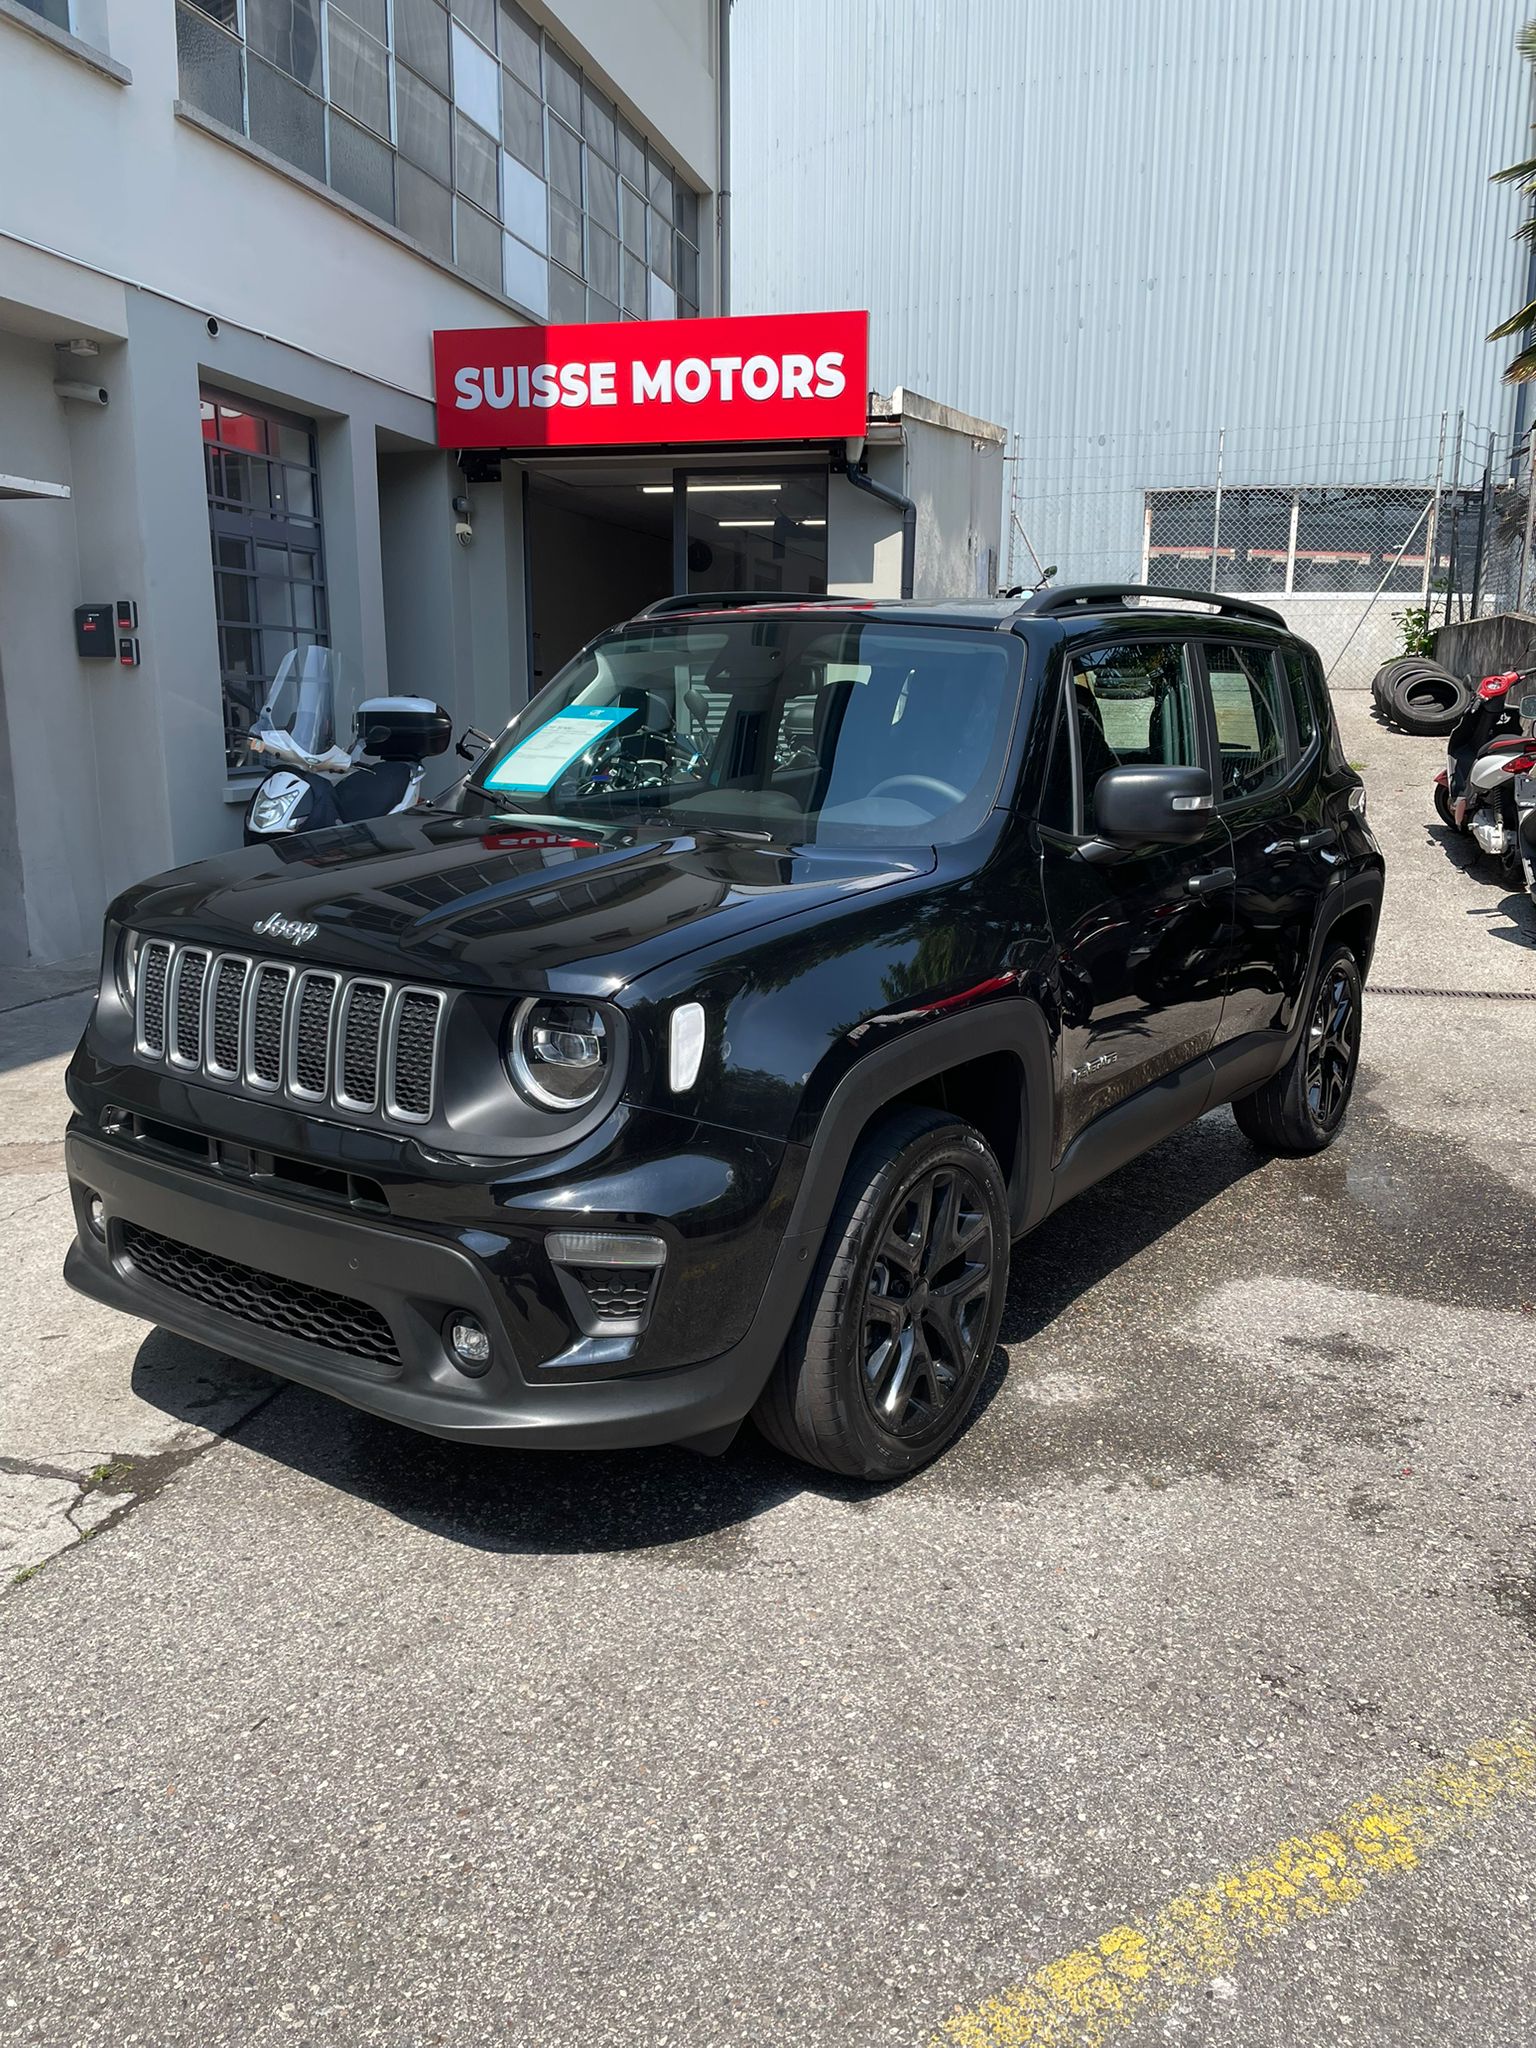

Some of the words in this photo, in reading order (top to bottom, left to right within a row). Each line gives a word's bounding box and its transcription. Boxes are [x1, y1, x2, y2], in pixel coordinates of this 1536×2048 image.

[455, 362, 617, 410] SUISSE
[632, 352, 846, 404] MOTORS
[253, 912, 319, 946] Jeep
